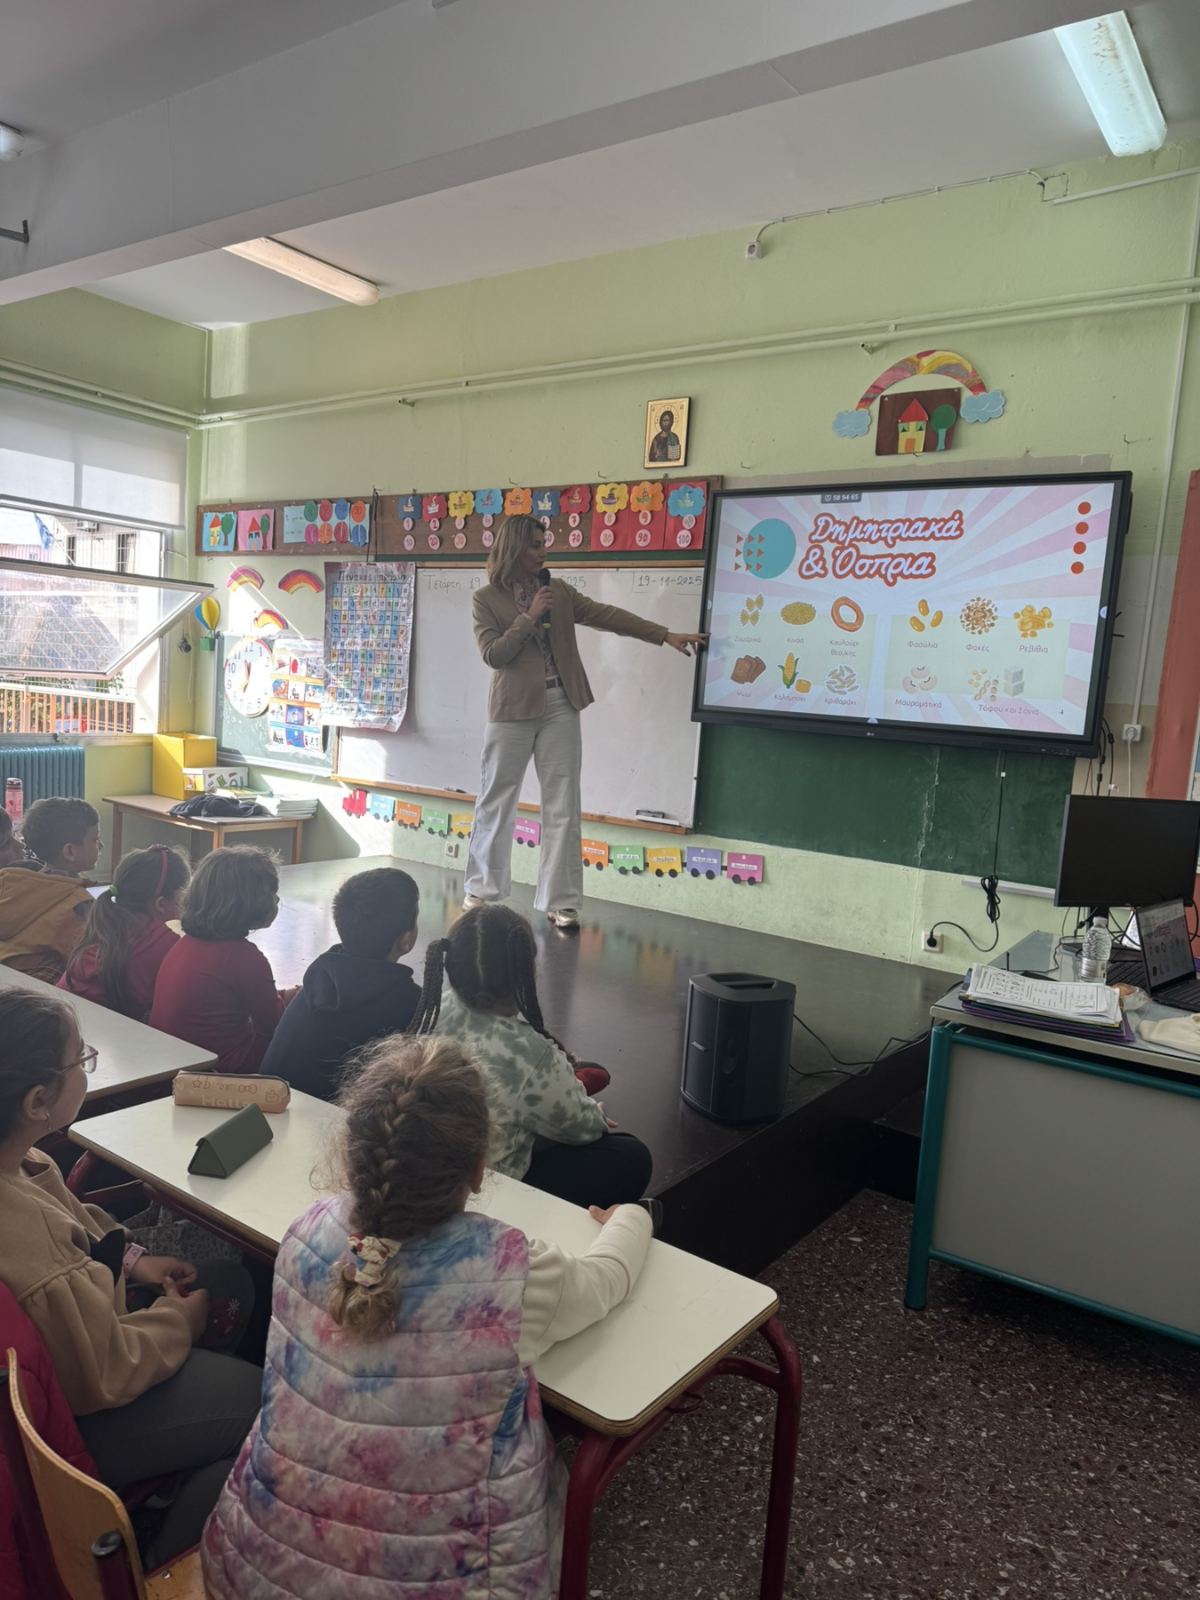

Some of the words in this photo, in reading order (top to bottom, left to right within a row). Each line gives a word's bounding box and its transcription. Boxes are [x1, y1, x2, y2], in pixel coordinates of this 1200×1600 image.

[809, 509, 964, 548] Δημητριακά
[677, 533, 691, 545] 100
[799, 543, 828, 580] &
[832, 543, 936, 587] Όσπρια
[470, 576, 481, 590] 19
[966, 643, 990, 653] Φακές
[1019, 644, 1049, 654] Ρεβίθια
[228, 662, 236, 674] 10
[226, 679, 232, 690] 9
